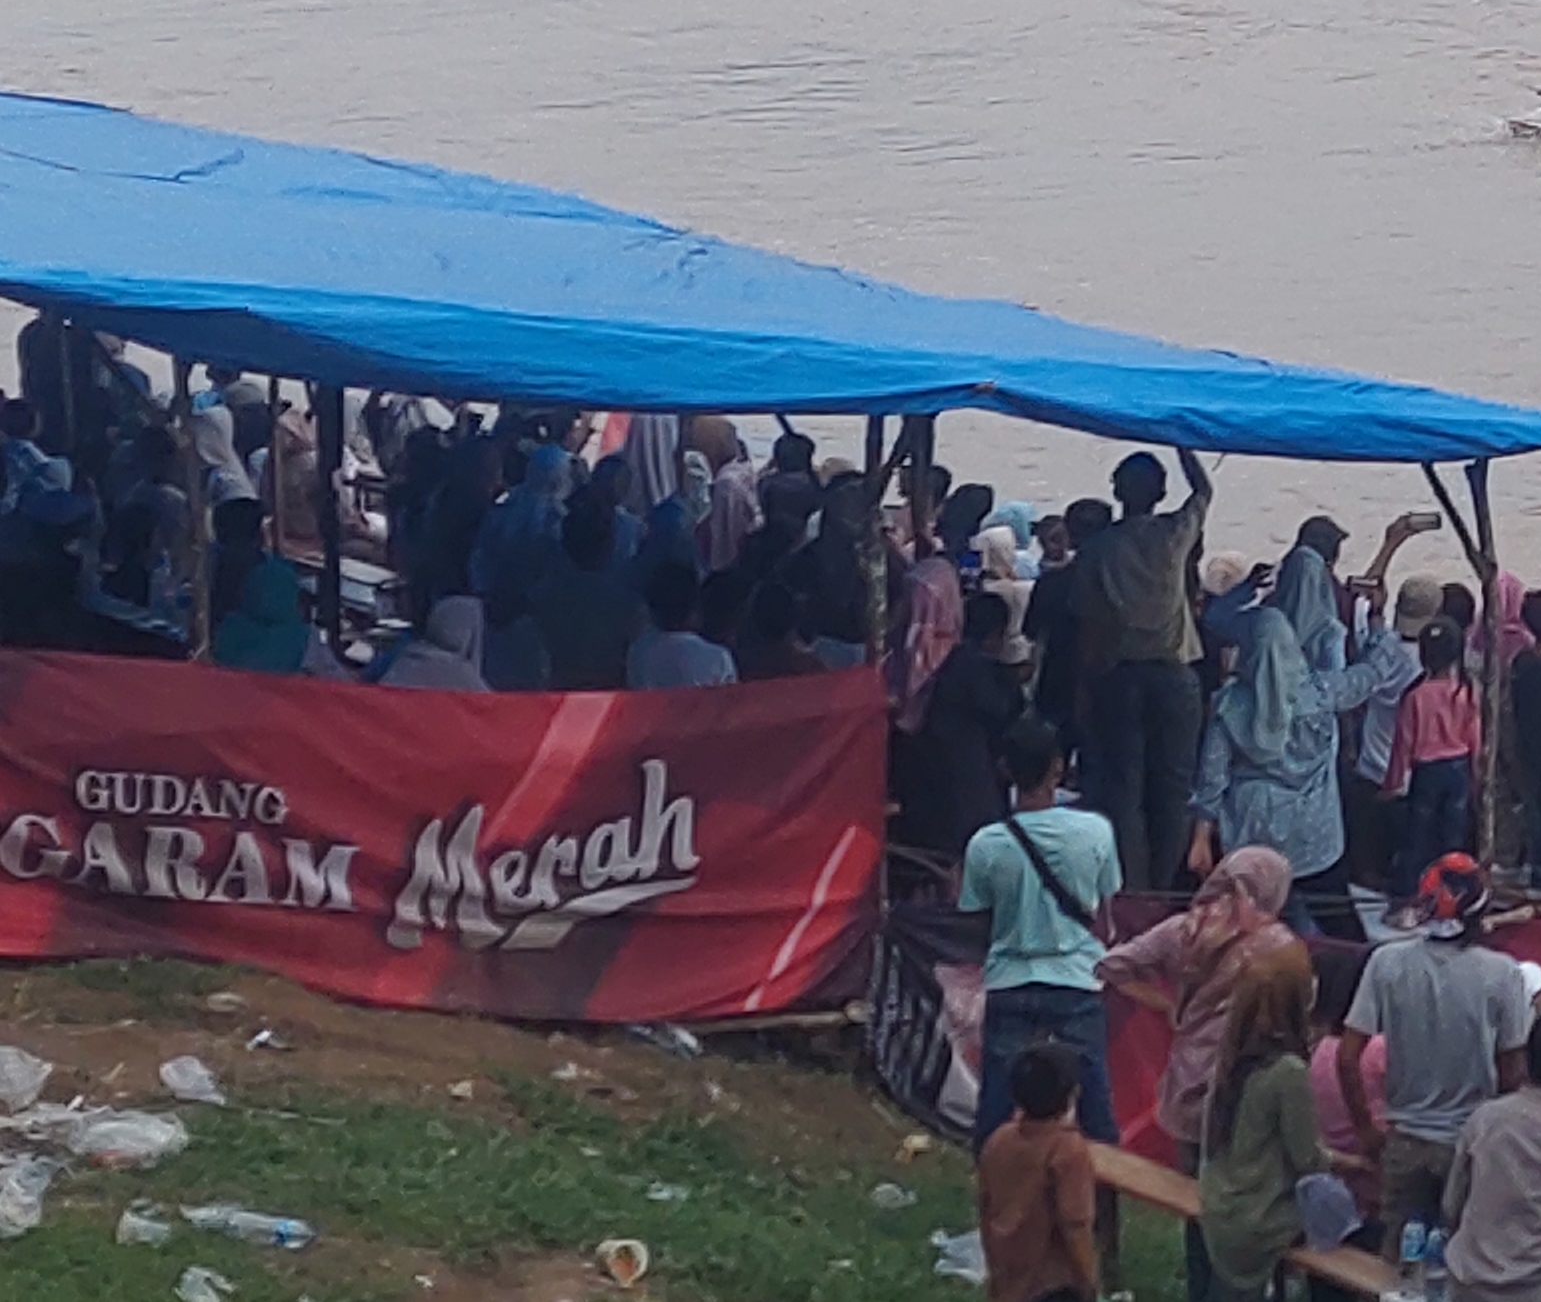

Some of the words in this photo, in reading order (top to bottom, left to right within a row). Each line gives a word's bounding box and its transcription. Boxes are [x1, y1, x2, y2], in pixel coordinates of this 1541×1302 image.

[0, 813, 362, 913] GARAM
[386, 758, 702, 950] Merah
[75, 770, 290, 825] GUDANG
